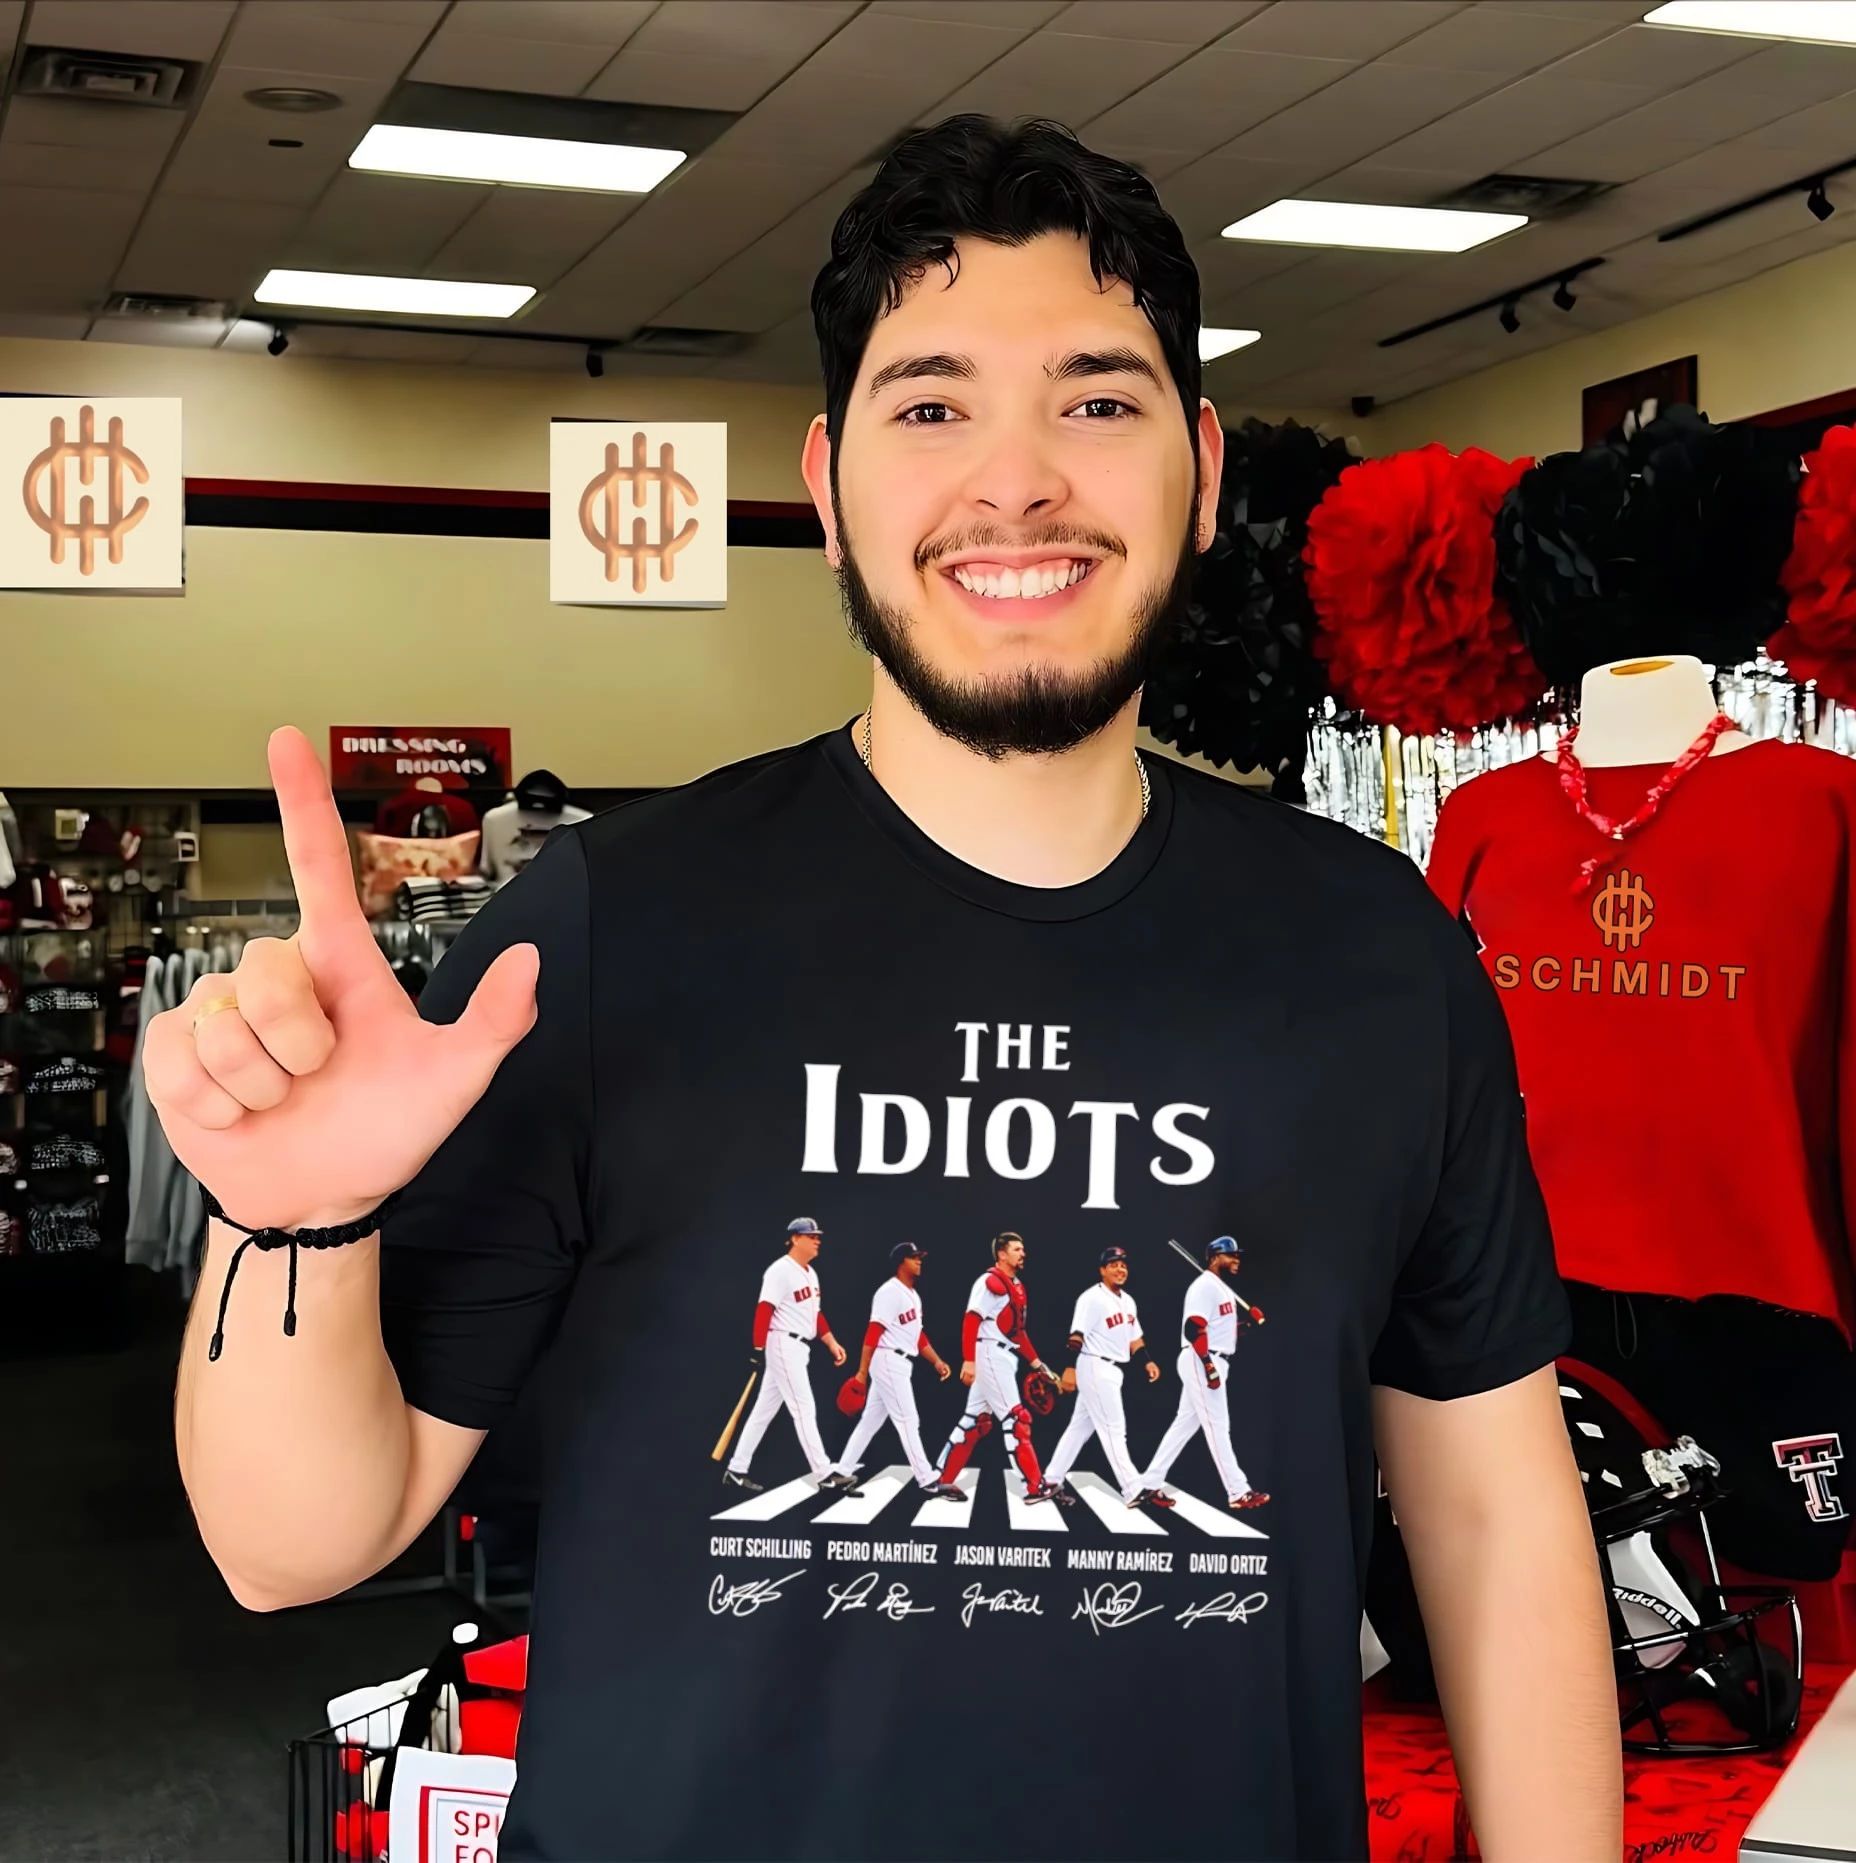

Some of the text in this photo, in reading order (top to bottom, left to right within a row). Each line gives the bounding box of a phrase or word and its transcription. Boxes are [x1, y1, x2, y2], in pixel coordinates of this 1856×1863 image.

[342, 737, 466, 753] DRESSING
[396, 758, 487, 774] ROOMS
[1494, 954, 1746, 1000] SCHMIDT
[955, 1022, 1070, 1082] THE
[801, 1063, 1215, 1209] IDIOTS
[710, 1537, 811, 1559] CURT SCHILLING
[827, 1540, 937, 1564] PEDRO MARTÍNEZ
[954, 1545, 1051, 1567] JASON VARITEK
[1068, 1548, 1173, 1572] MANNY RAMÍREZ
[1190, 1553, 1267, 1575] DAVID ORTIZ
